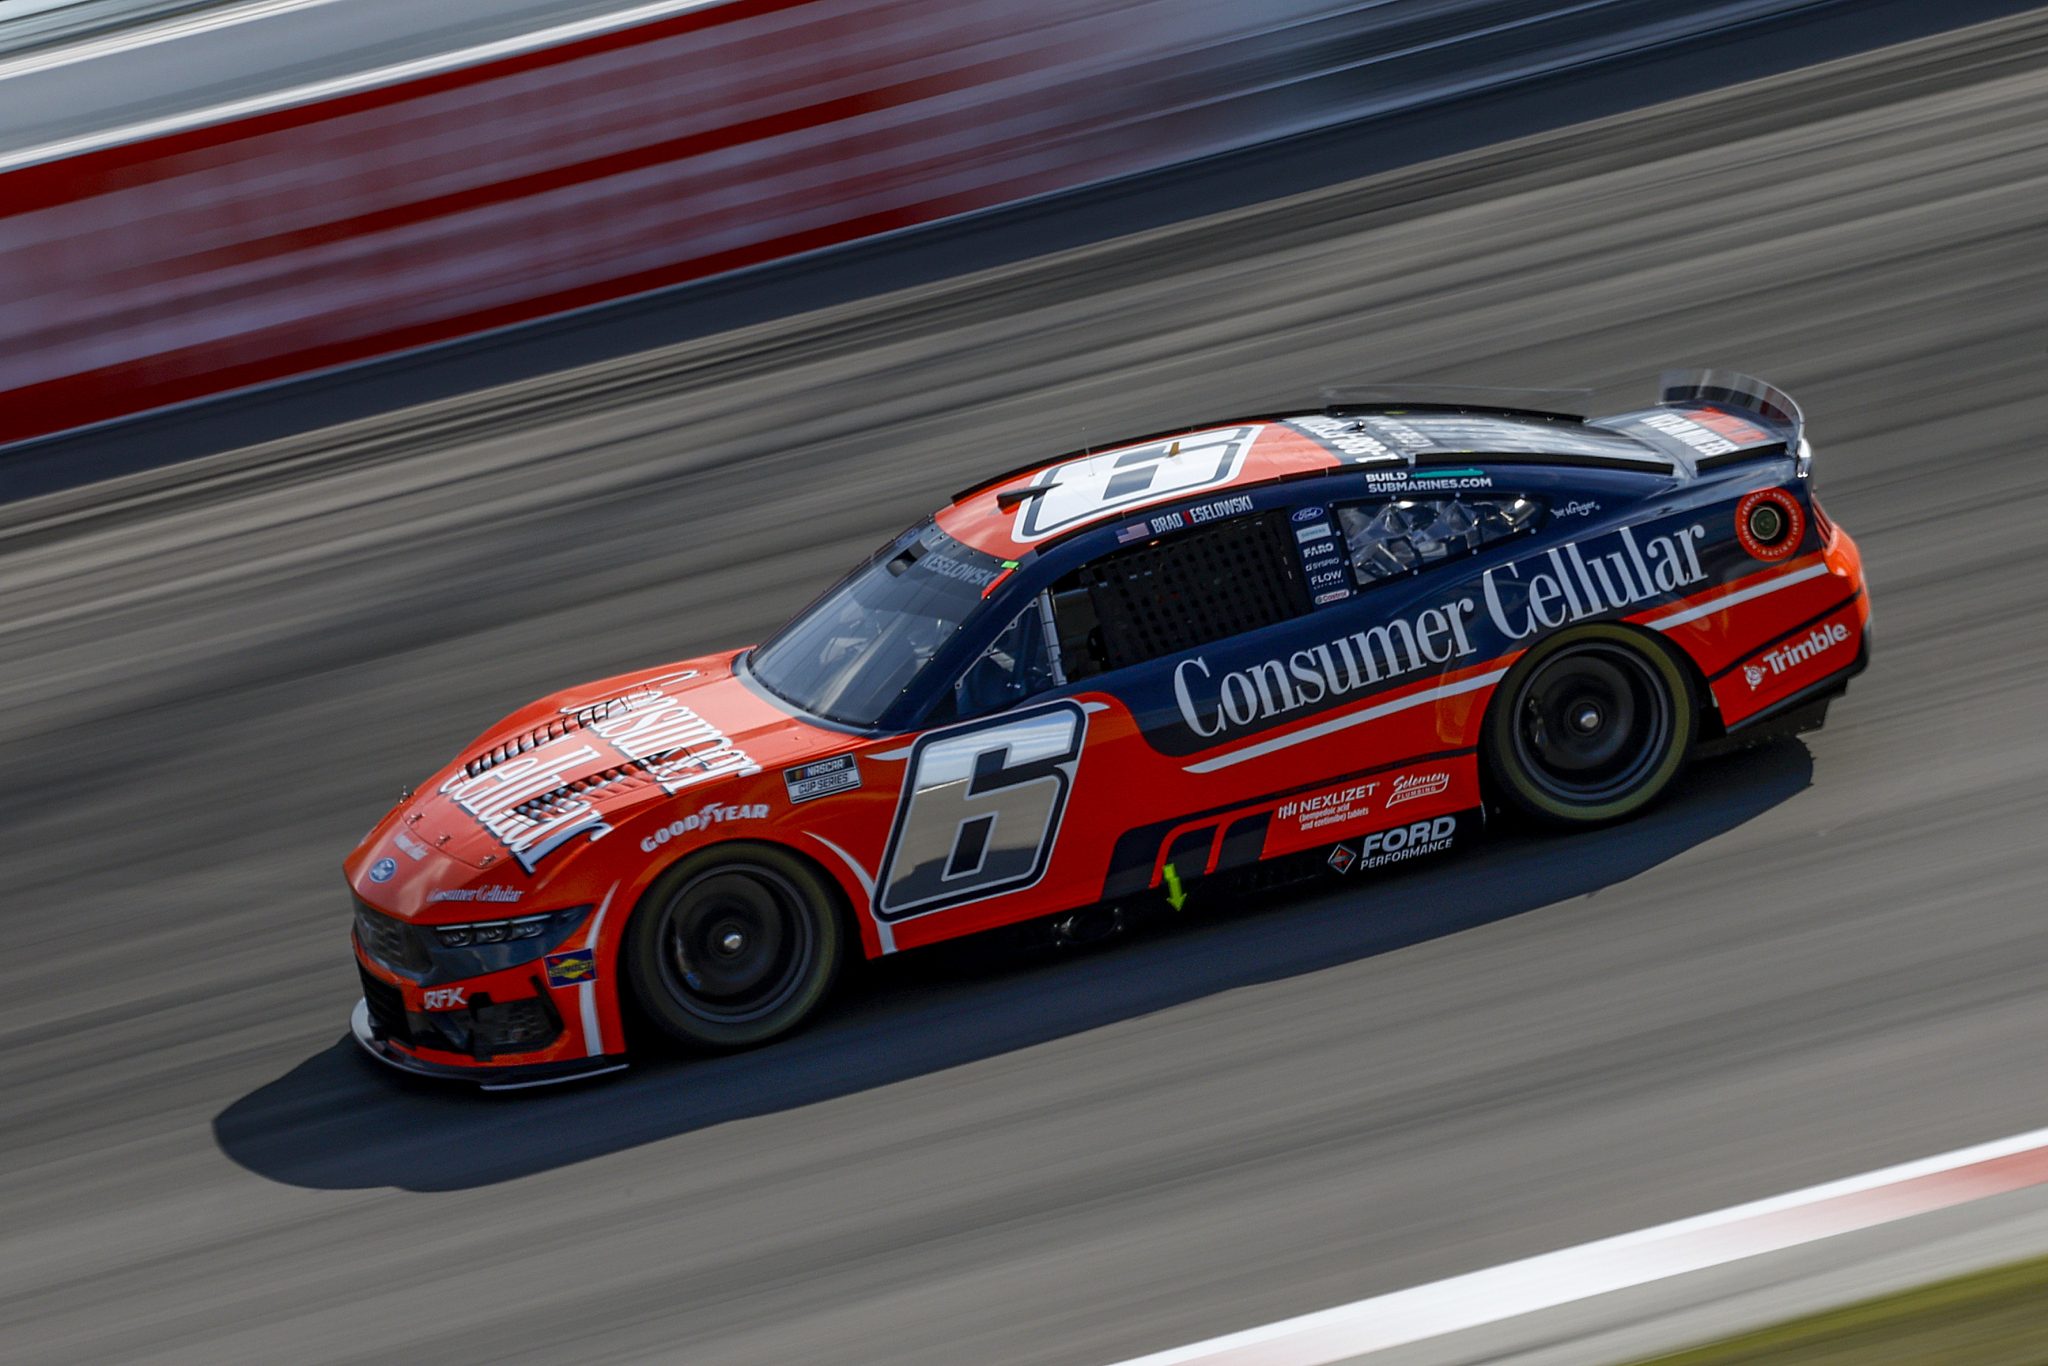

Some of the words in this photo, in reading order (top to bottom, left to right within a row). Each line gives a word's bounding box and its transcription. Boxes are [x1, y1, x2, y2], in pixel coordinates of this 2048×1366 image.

[1010, 424, 1265, 543] 6
[1366, 471, 1408, 484] BUILD
[1368, 477, 1493, 493] SUBMARINES.COM
[1151, 512, 1184, 534] BRAD
[1303, 543, 1335, 558] FARO
[921, 552, 999, 587] KESELOWSK
[1311, 570, 1342, 585] FLOW
[1173, 597, 1477, 738] Consumer
[1483, 524, 1709, 640] Cellular
[1763, 623, 1850, 675] Trimble
[806, 758, 846, 777] NASCAR
[798, 781, 819, 795] CUP
[818, 773, 849, 790] SERIES
[1300, 783, 1377, 813] NEXLIZET
[871, 698, 1088, 923] 6
[640, 802, 770, 852] GOODYEAR
[1361, 815, 1457, 858] FORD
[1360, 837, 1453, 870] PERFORMANCE
[423, 987, 468, 1010] RFK
